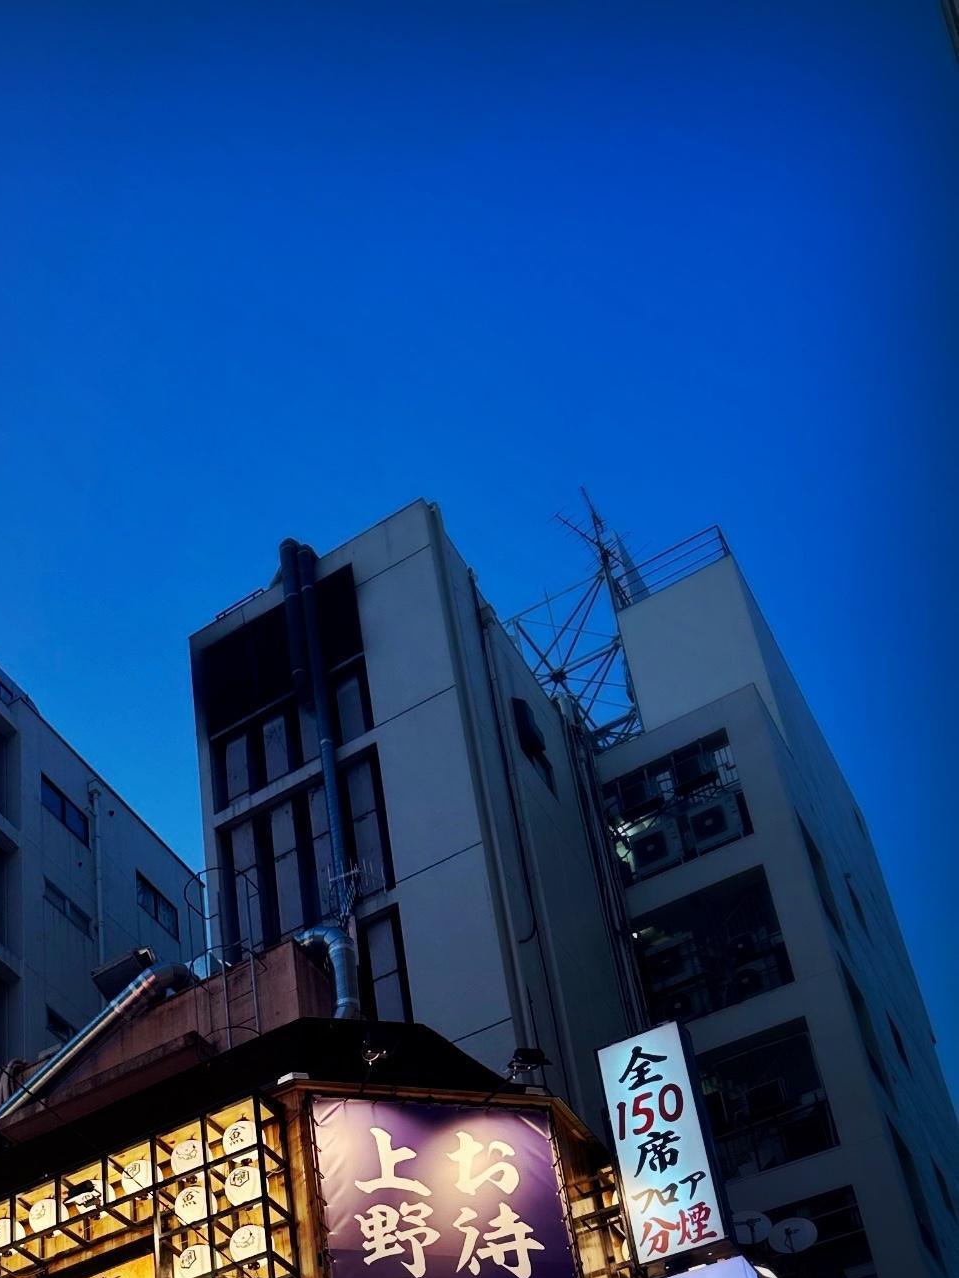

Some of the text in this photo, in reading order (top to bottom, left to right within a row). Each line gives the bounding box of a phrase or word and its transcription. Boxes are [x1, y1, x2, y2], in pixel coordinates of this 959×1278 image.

[632, 1170, 707, 1212] フロア
[640, 1202, 717, 1257] 分煙
